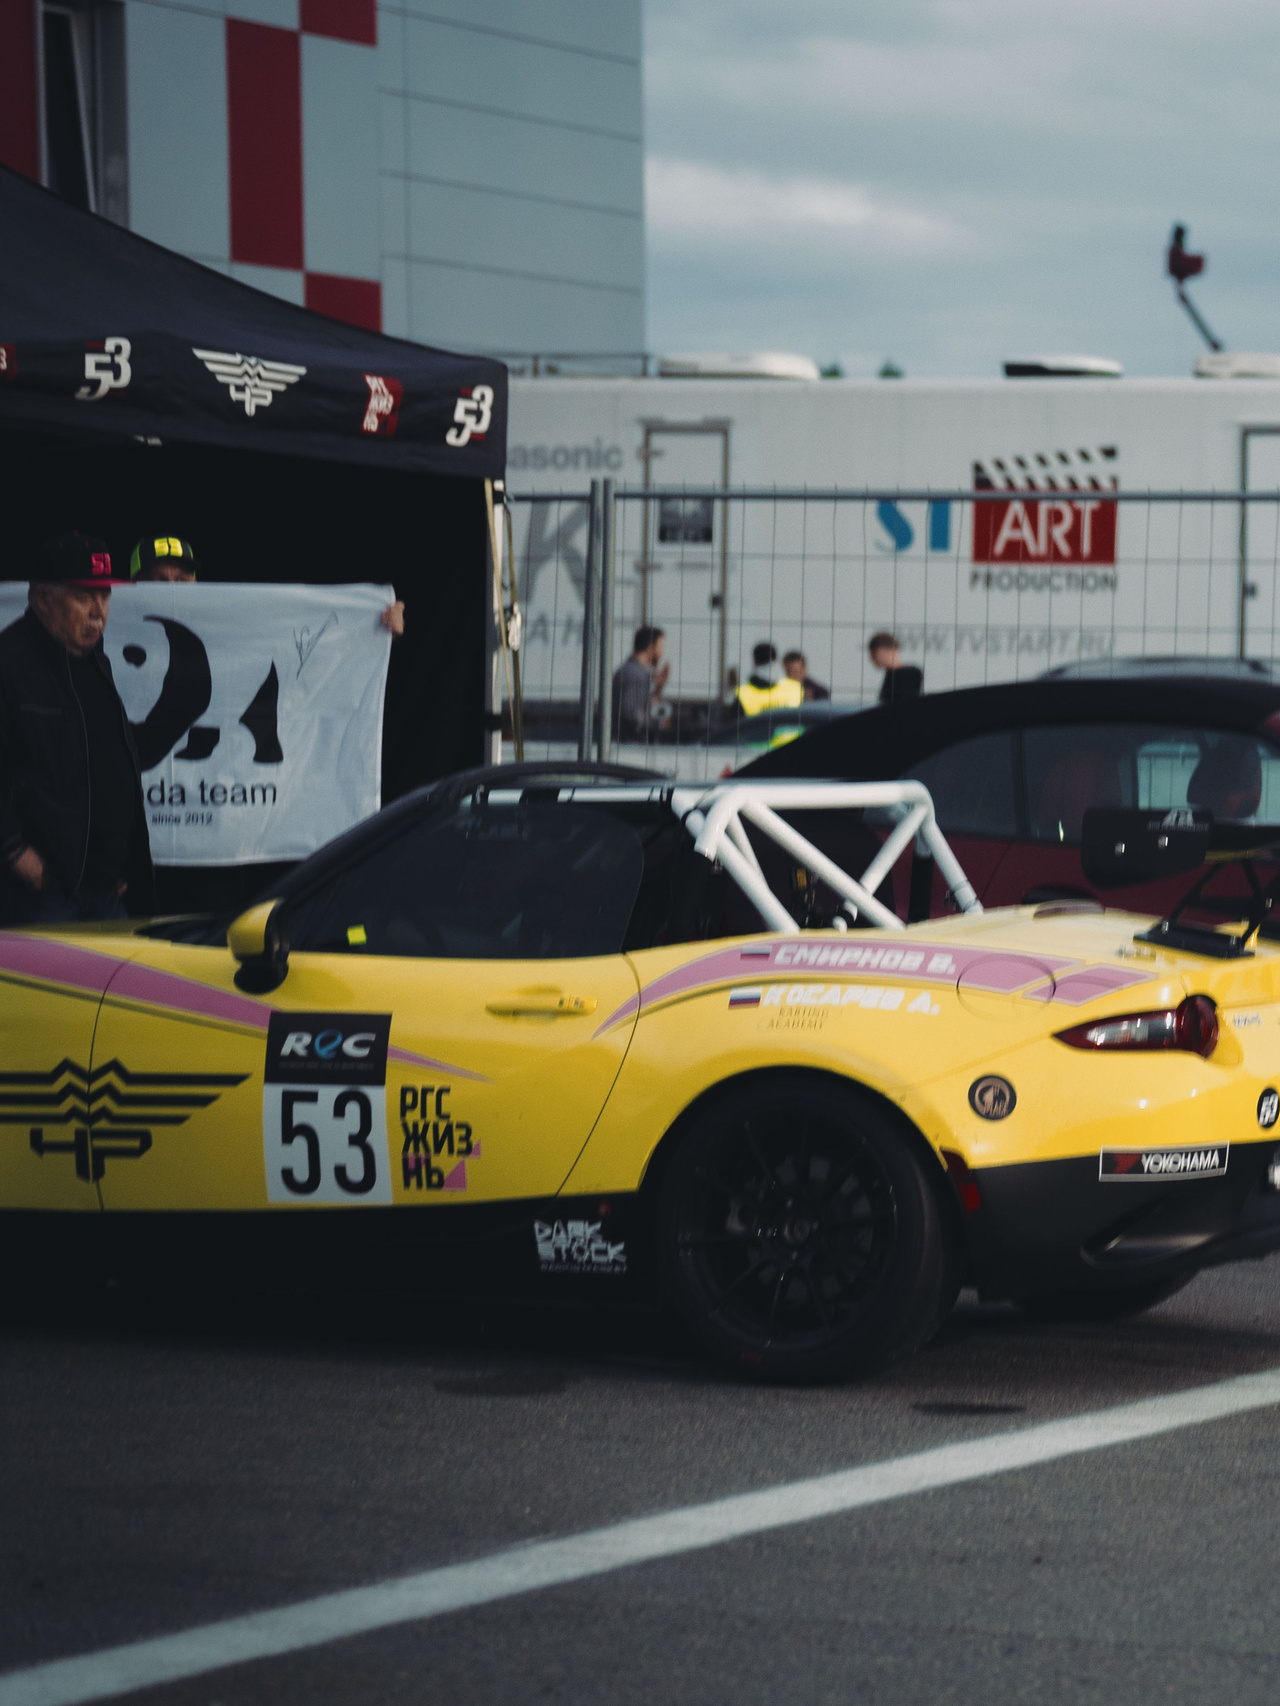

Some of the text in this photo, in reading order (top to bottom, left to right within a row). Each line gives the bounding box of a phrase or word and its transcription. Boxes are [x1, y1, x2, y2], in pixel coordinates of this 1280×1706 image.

[446, 384, 494, 447] 53
[508, 437, 623, 471] asonic
[992, 499, 1101, 558] ART
[969, 569, 1118, 593] PRODUCTION
[146, 779, 277, 807] da team
[151, 811, 214, 827] since 2012
[774, 944, 925, 973] СМИРНОВ
[400, 1085, 452, 1120] РГС
[281, 1089, 377, 1196] 53
[401, 1120, 474, 1157] ЖИЗ
[401, 1155, 446, 1190] НЬ
[1141, 1149, 1220, 1174] YOKOHAMA
